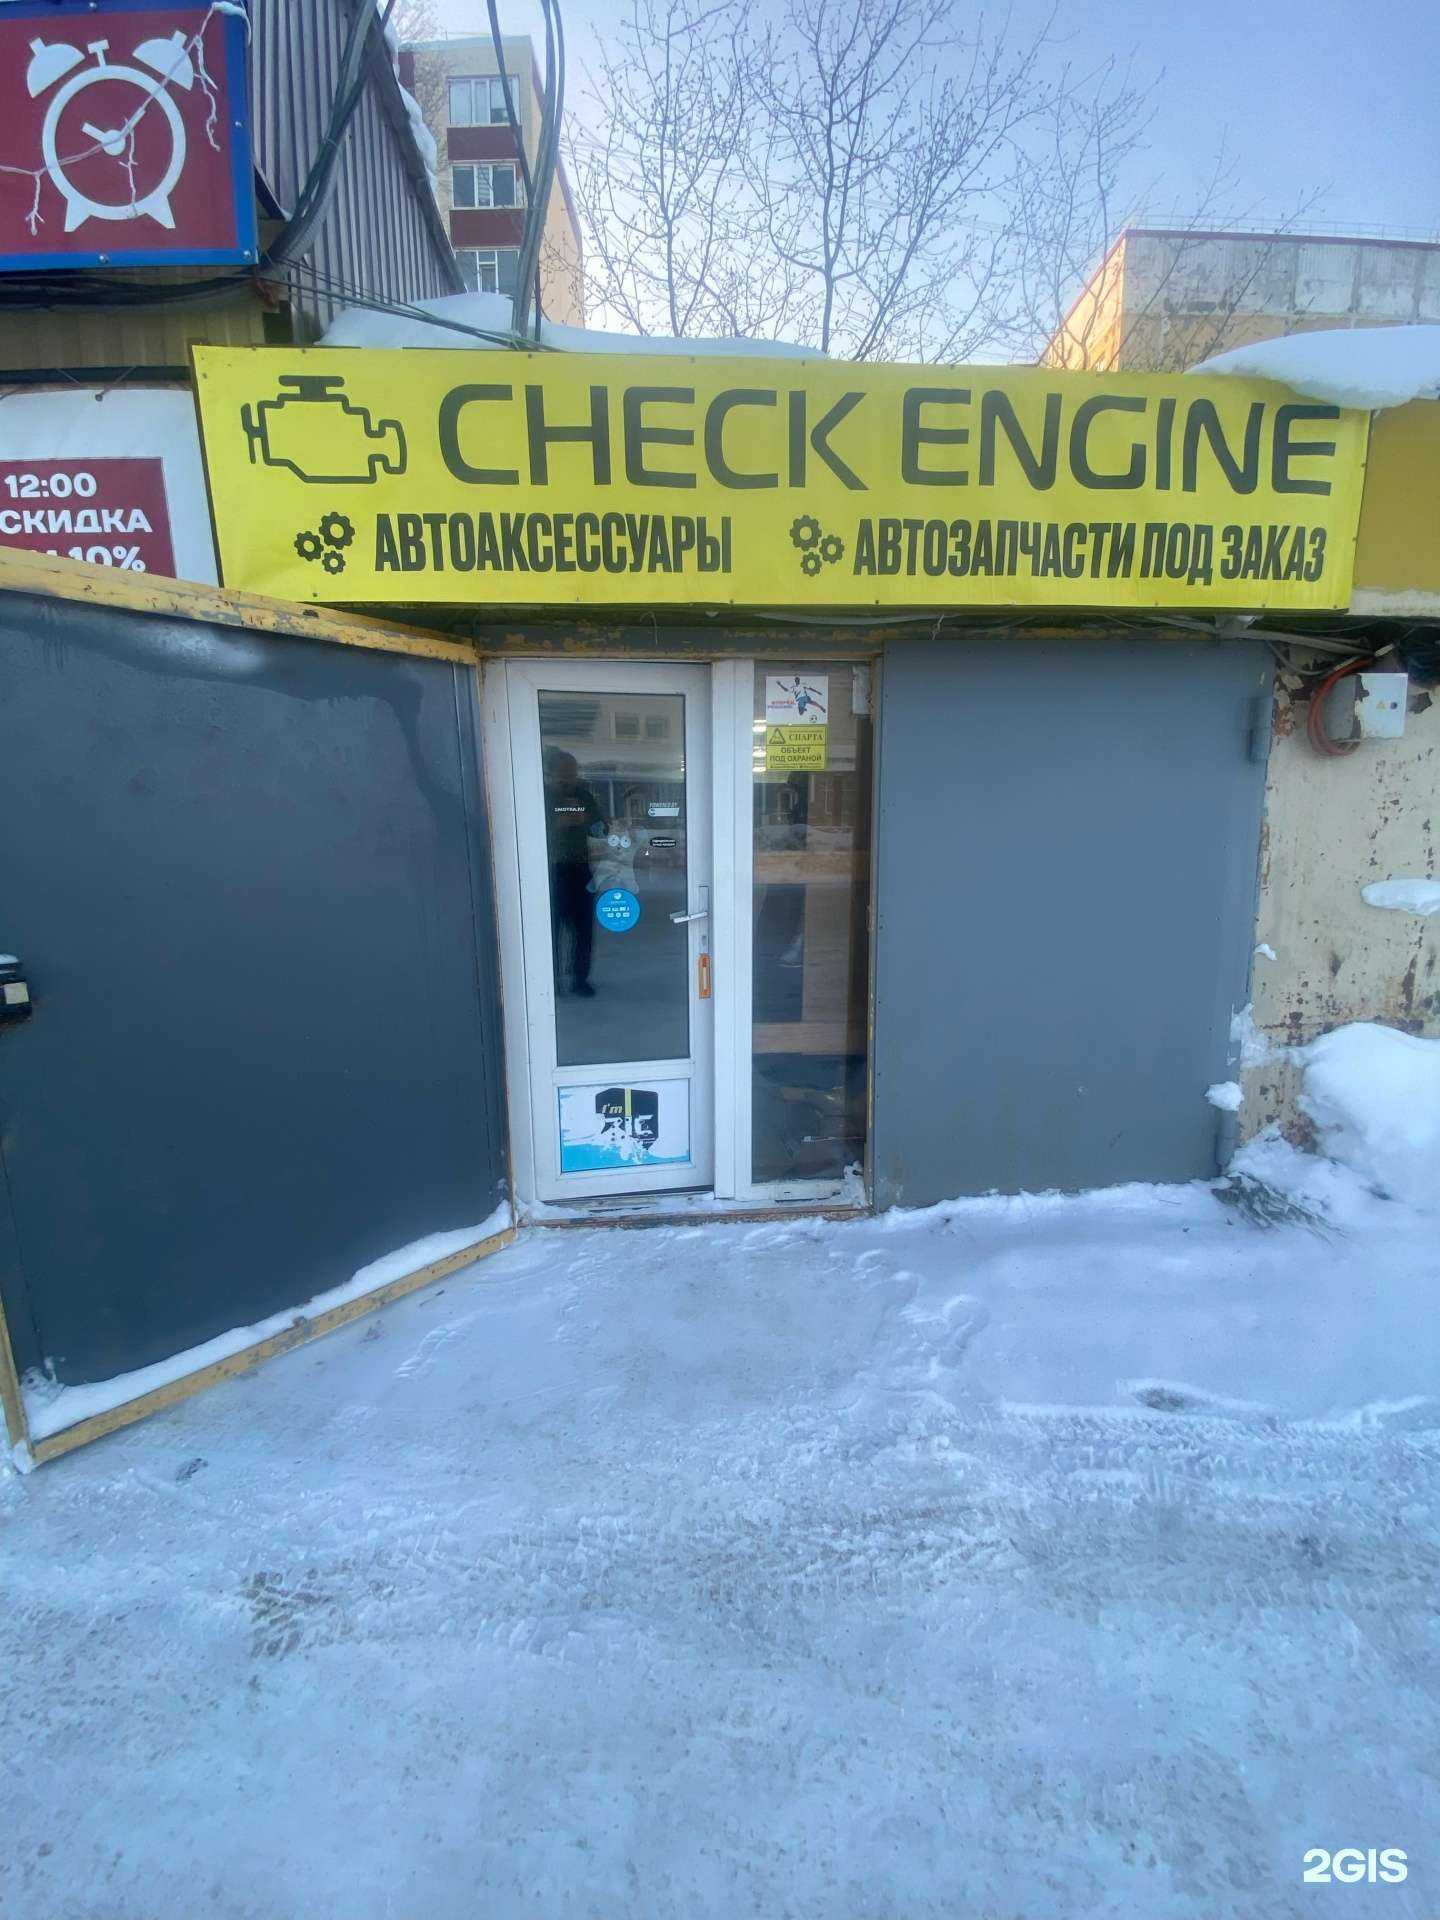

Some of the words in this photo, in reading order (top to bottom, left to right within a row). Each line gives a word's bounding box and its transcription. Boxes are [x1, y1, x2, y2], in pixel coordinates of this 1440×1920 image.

[438, 384, 869, 491] CHECK
[901, 387, 1340, 497] ENGINE
[4, 472, 98, 498] 12:00
[0, 508, 153, 534] СКИДКА
[374, 512, 732, 573] АВТОАКСЕССУАРЫ
[852, 517, 1136, 578] АВТОЗАПЧАСТИ
[1139, 522, 1214, 586] ПОД
[1220, 524, 1328, 582] ЗАКАЗ
[769, 755, 786, 763] ПОД
[780, 746, 811, 754] ОБЪЕКТ
